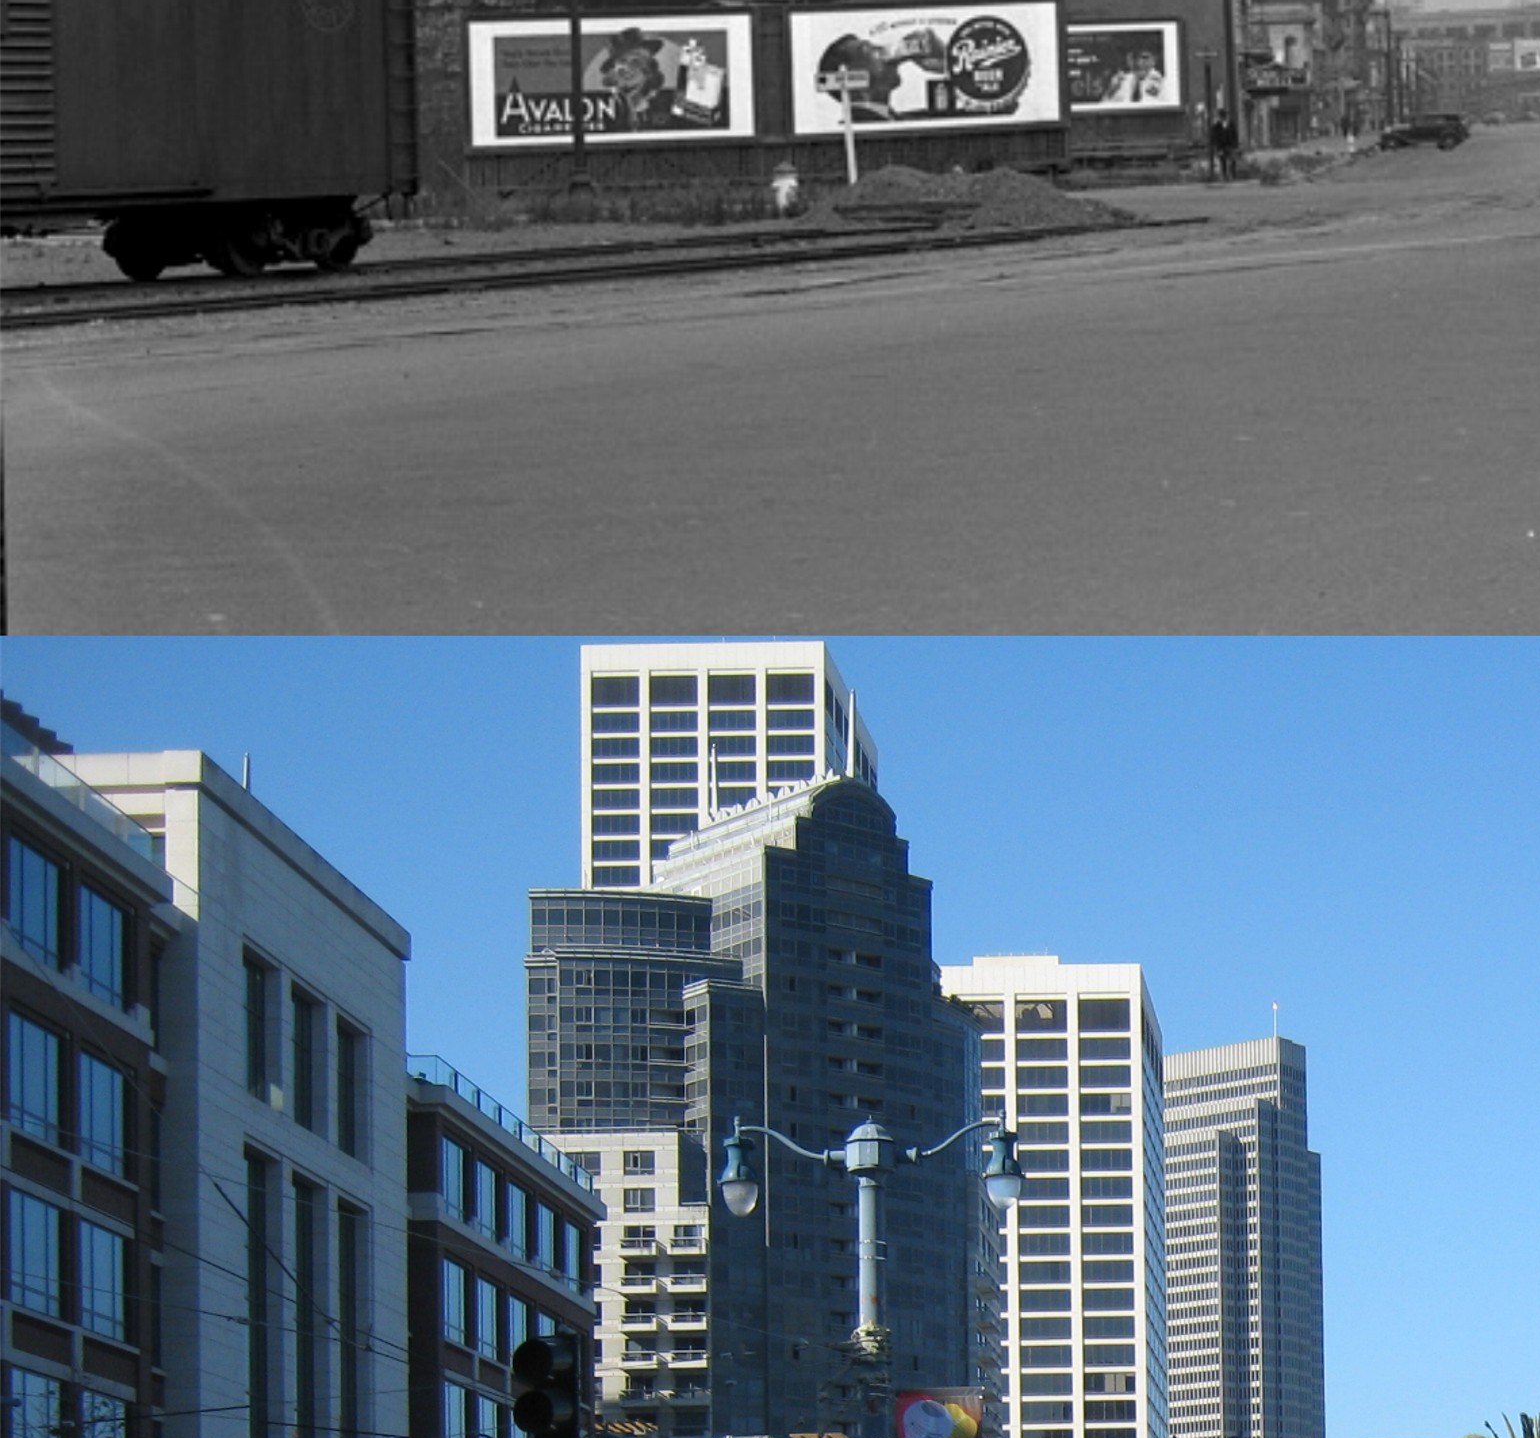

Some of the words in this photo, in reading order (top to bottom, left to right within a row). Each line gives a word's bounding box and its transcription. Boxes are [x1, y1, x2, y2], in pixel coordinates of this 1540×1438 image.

[953, 39, 1022, 74] Rainier
[500, 92, 617, 124] AVALON
[518, 122, 605, 134] CIGARETES
